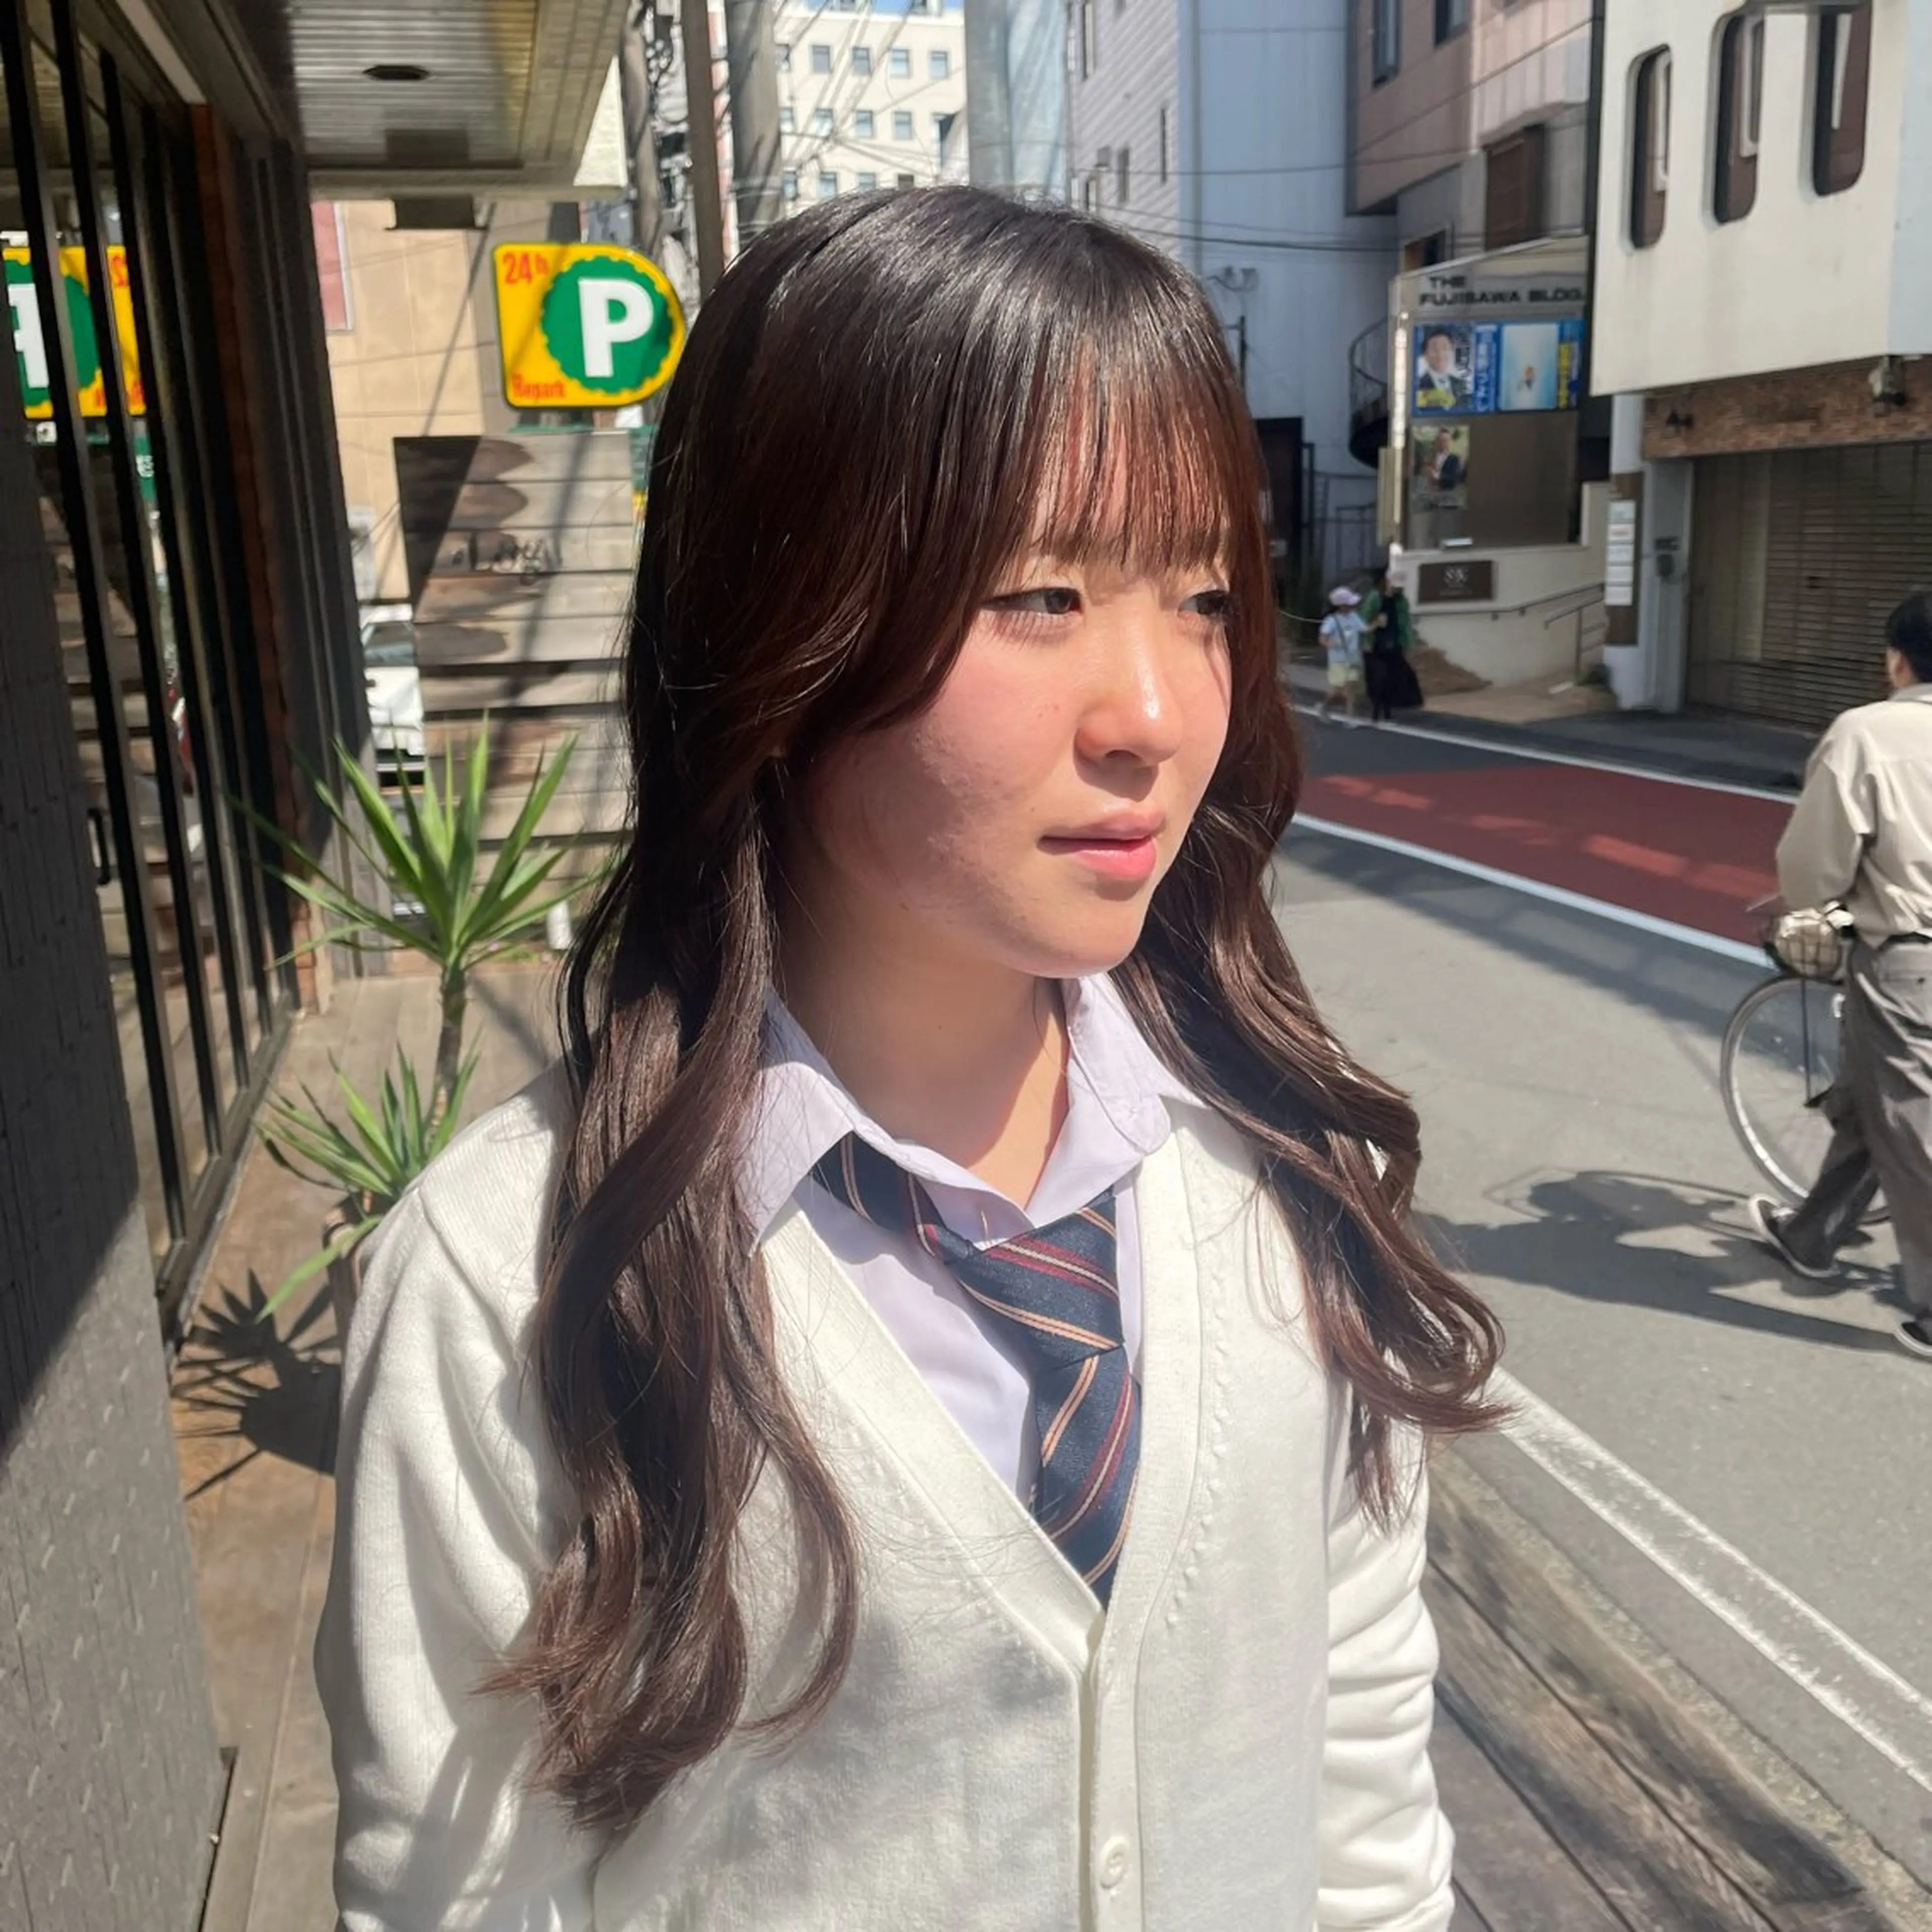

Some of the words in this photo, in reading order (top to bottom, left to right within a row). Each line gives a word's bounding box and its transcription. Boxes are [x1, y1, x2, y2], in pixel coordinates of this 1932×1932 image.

[1430, 276, 1466, 288] THE
[1420, 290, 1520, 305] FUJISAWA
[579, 279, 654, 377] P
